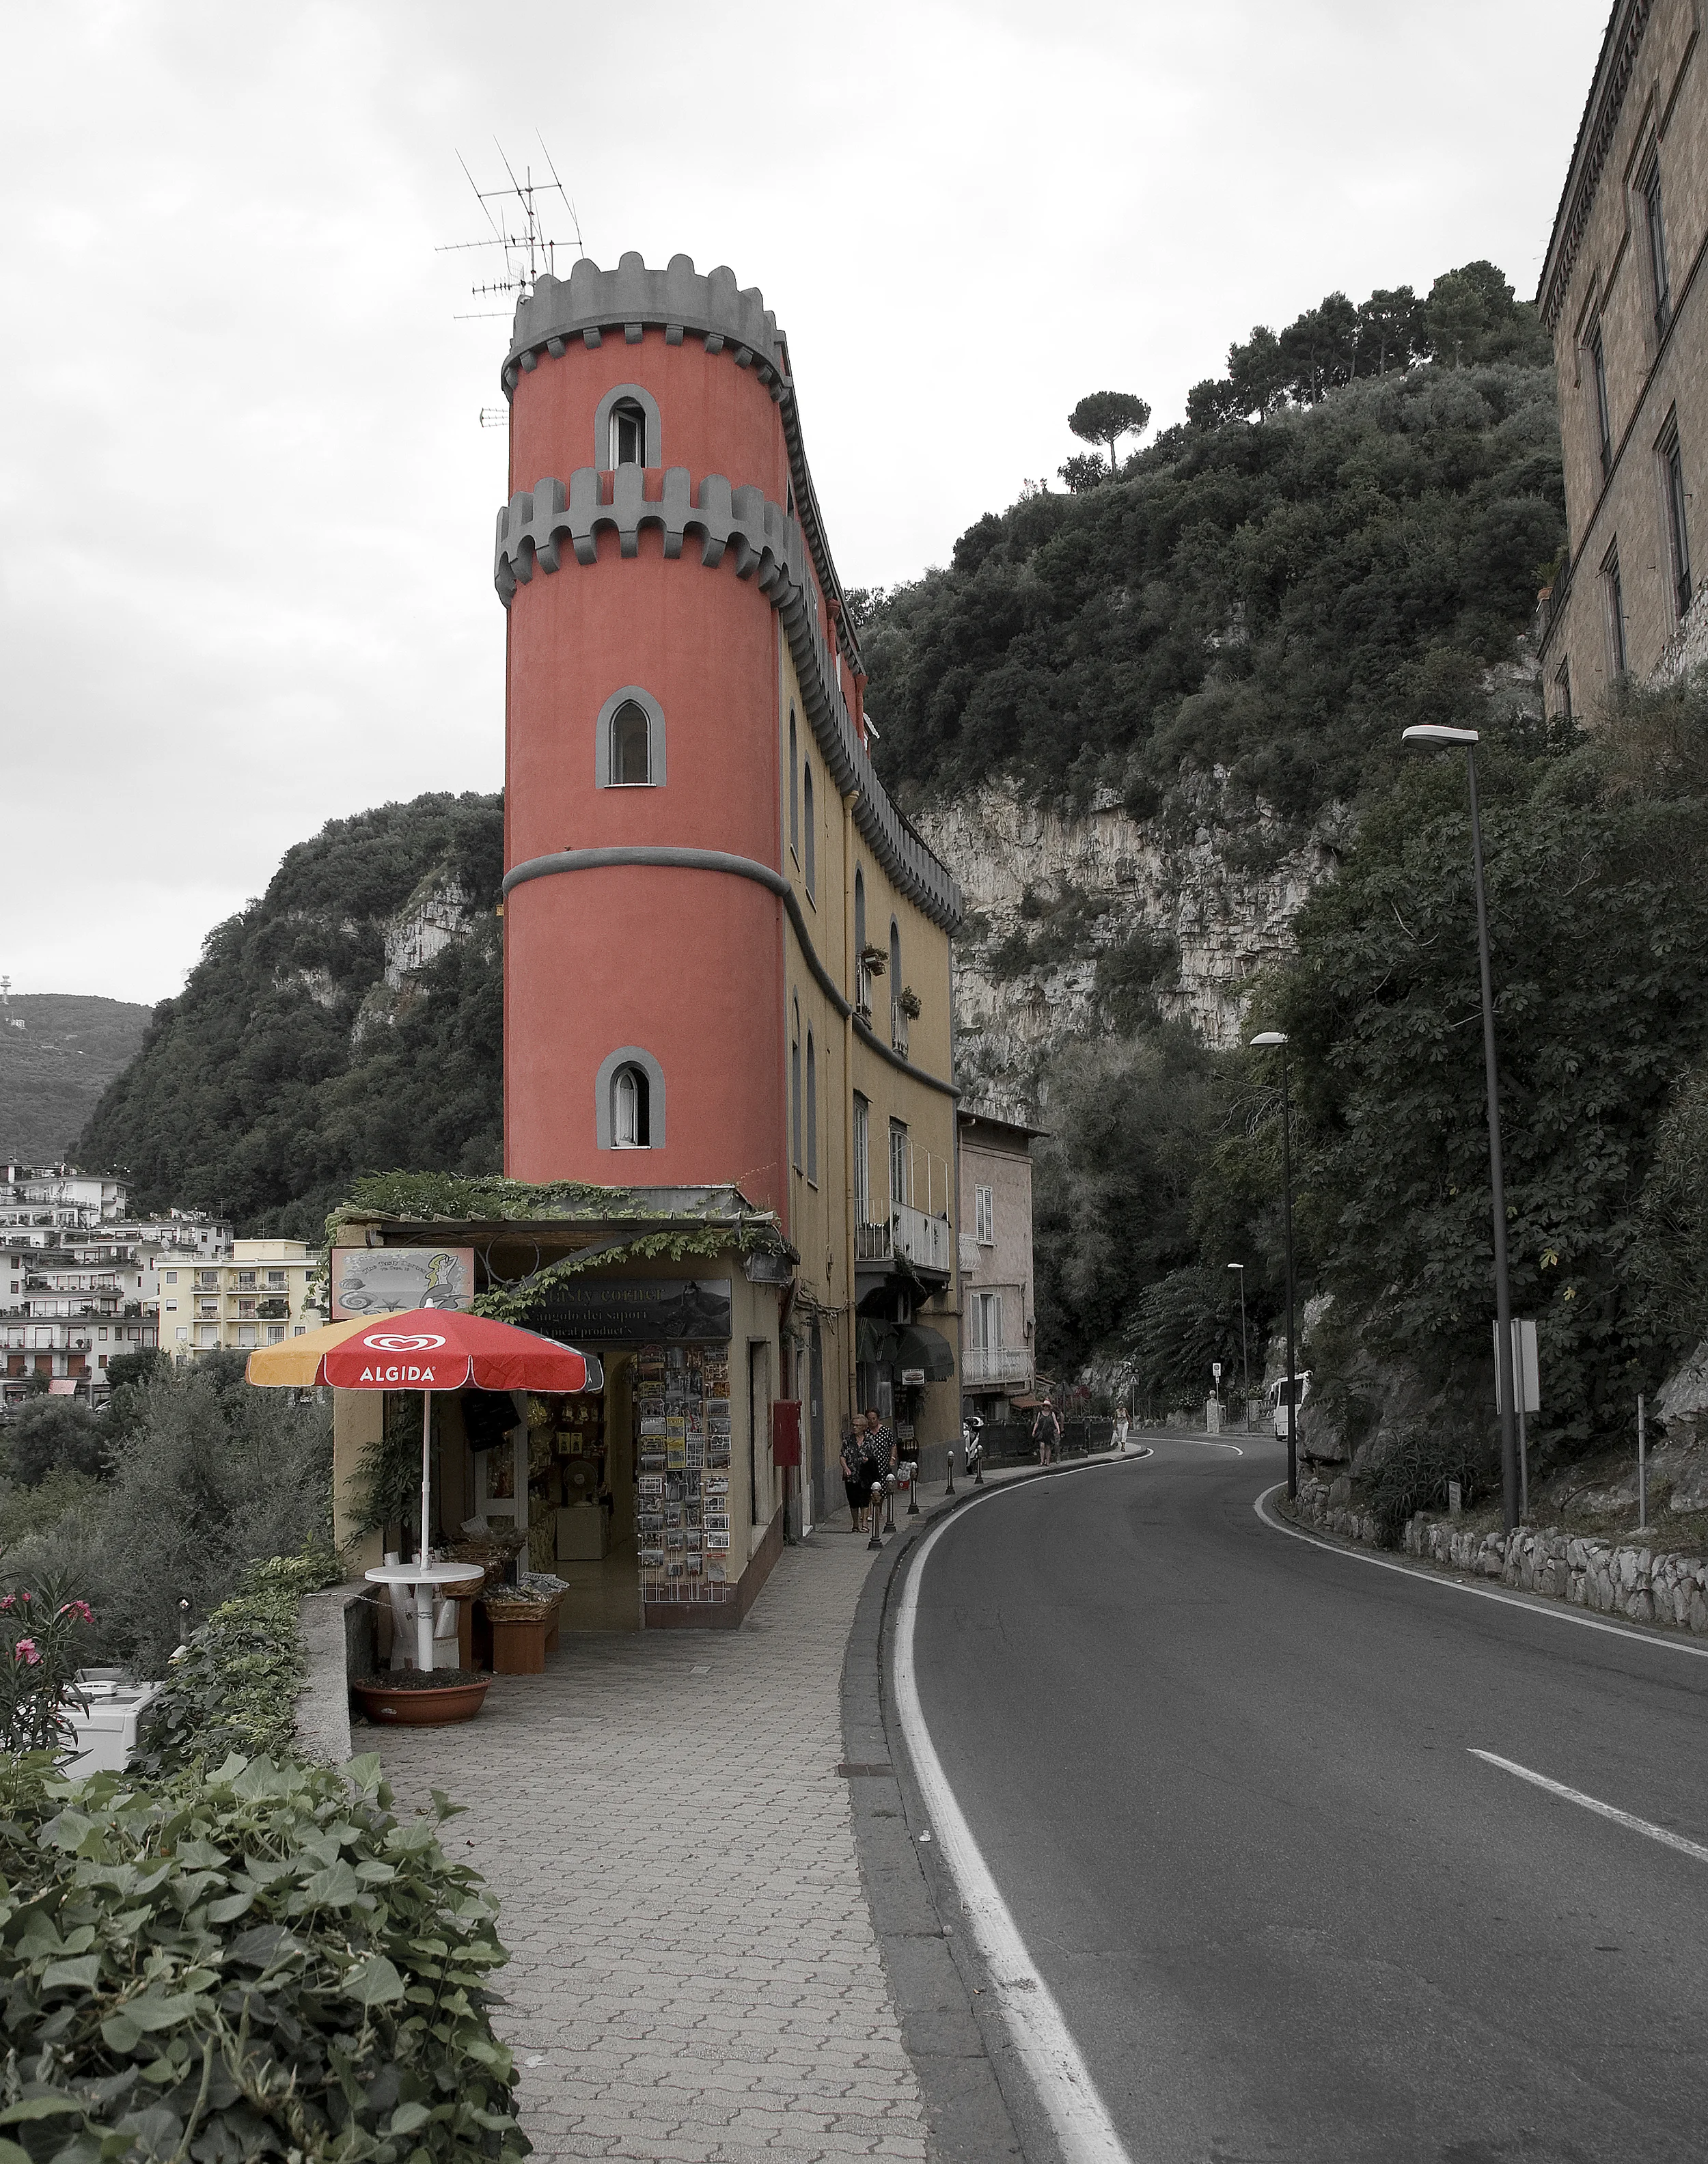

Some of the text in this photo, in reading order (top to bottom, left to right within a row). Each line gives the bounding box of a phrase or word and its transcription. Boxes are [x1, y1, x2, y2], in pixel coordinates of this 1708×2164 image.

[549, 1287, 665, 1306] tasty corner
[583, 1309, 603, 1321] dei
[607, 1308, 646, 1323] sapori
[359, 1365, 435, 1382] ALGIDA
